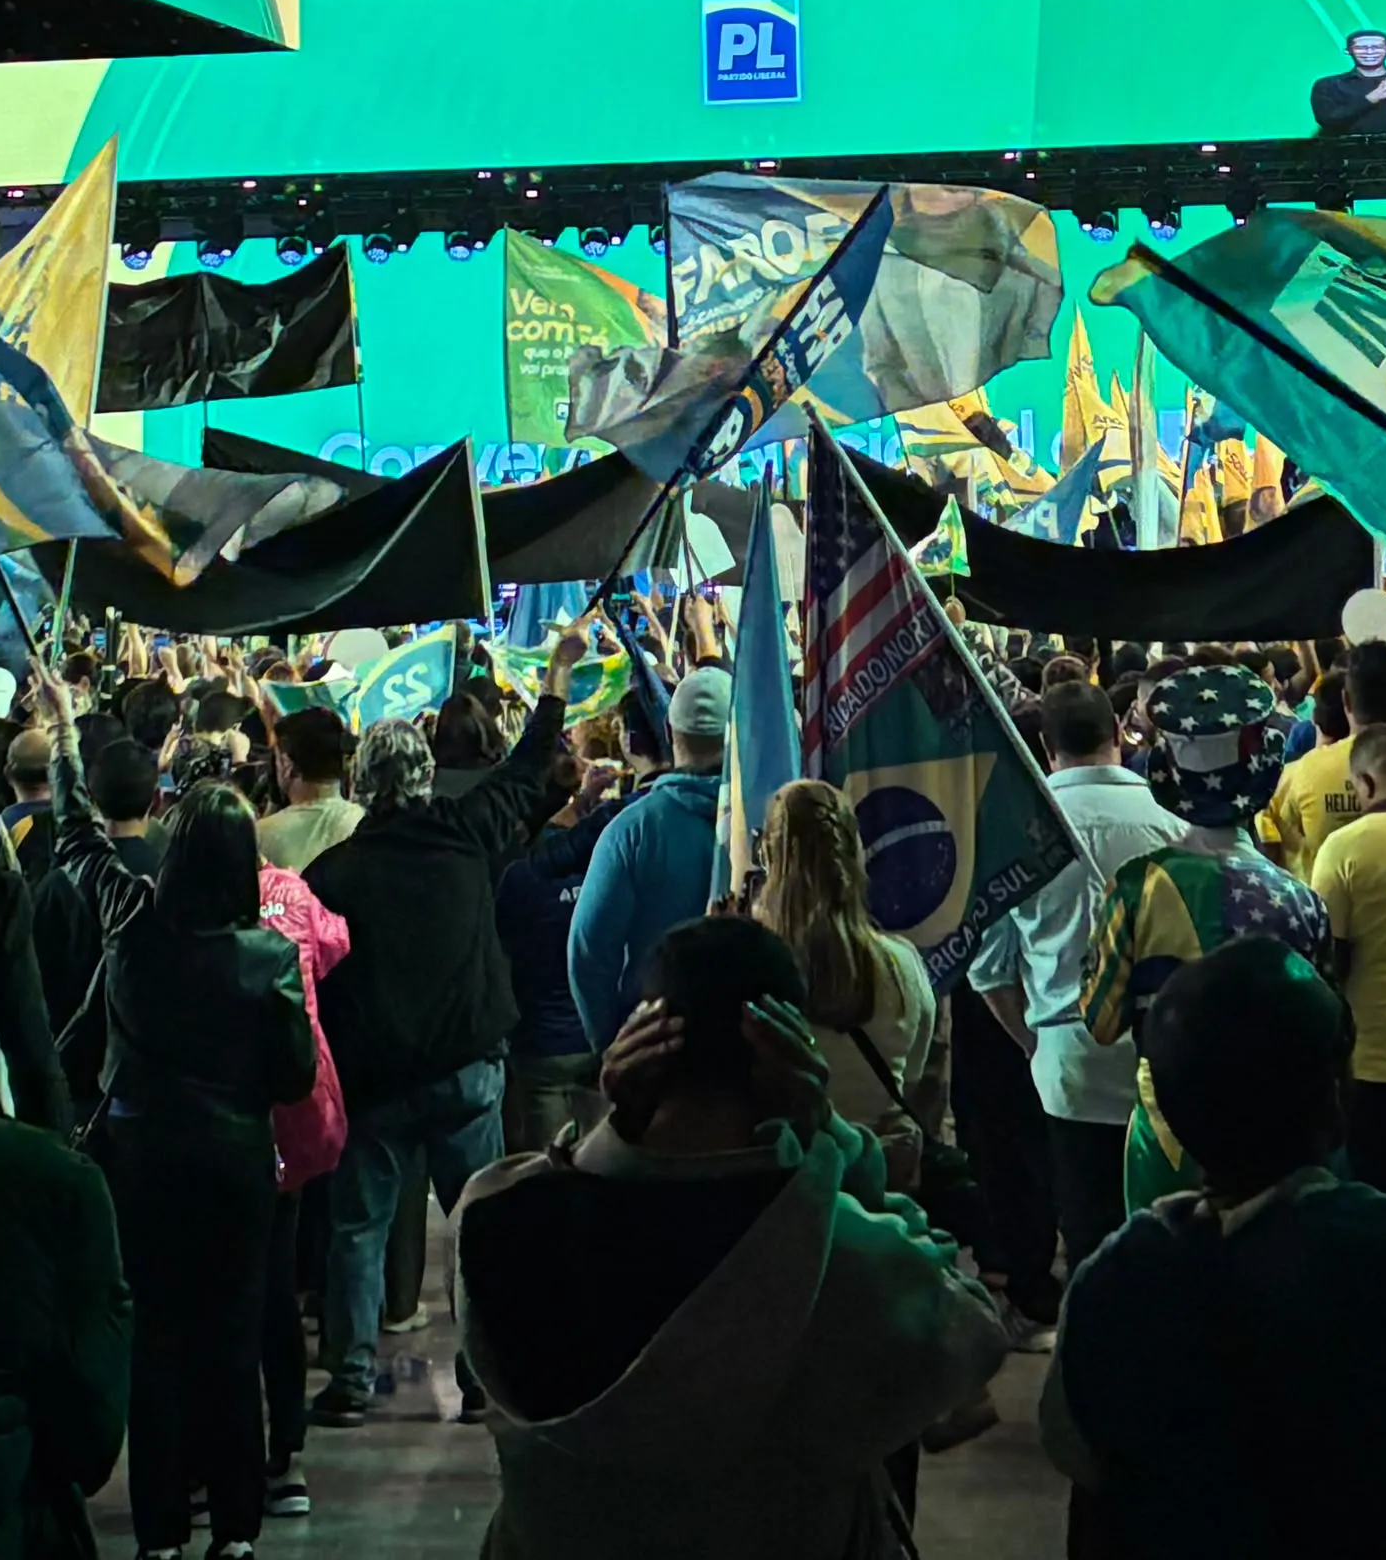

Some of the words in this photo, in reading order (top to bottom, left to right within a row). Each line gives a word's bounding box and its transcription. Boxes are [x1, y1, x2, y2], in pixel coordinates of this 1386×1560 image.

[718, 22, 785, 70] PL
[717, 72, 753, 81] PARTIDO
[754, 71, 786, 80] LIBERAL
[507, 320, 574, 343] com
[987, 863, 1037, 903] SUL
